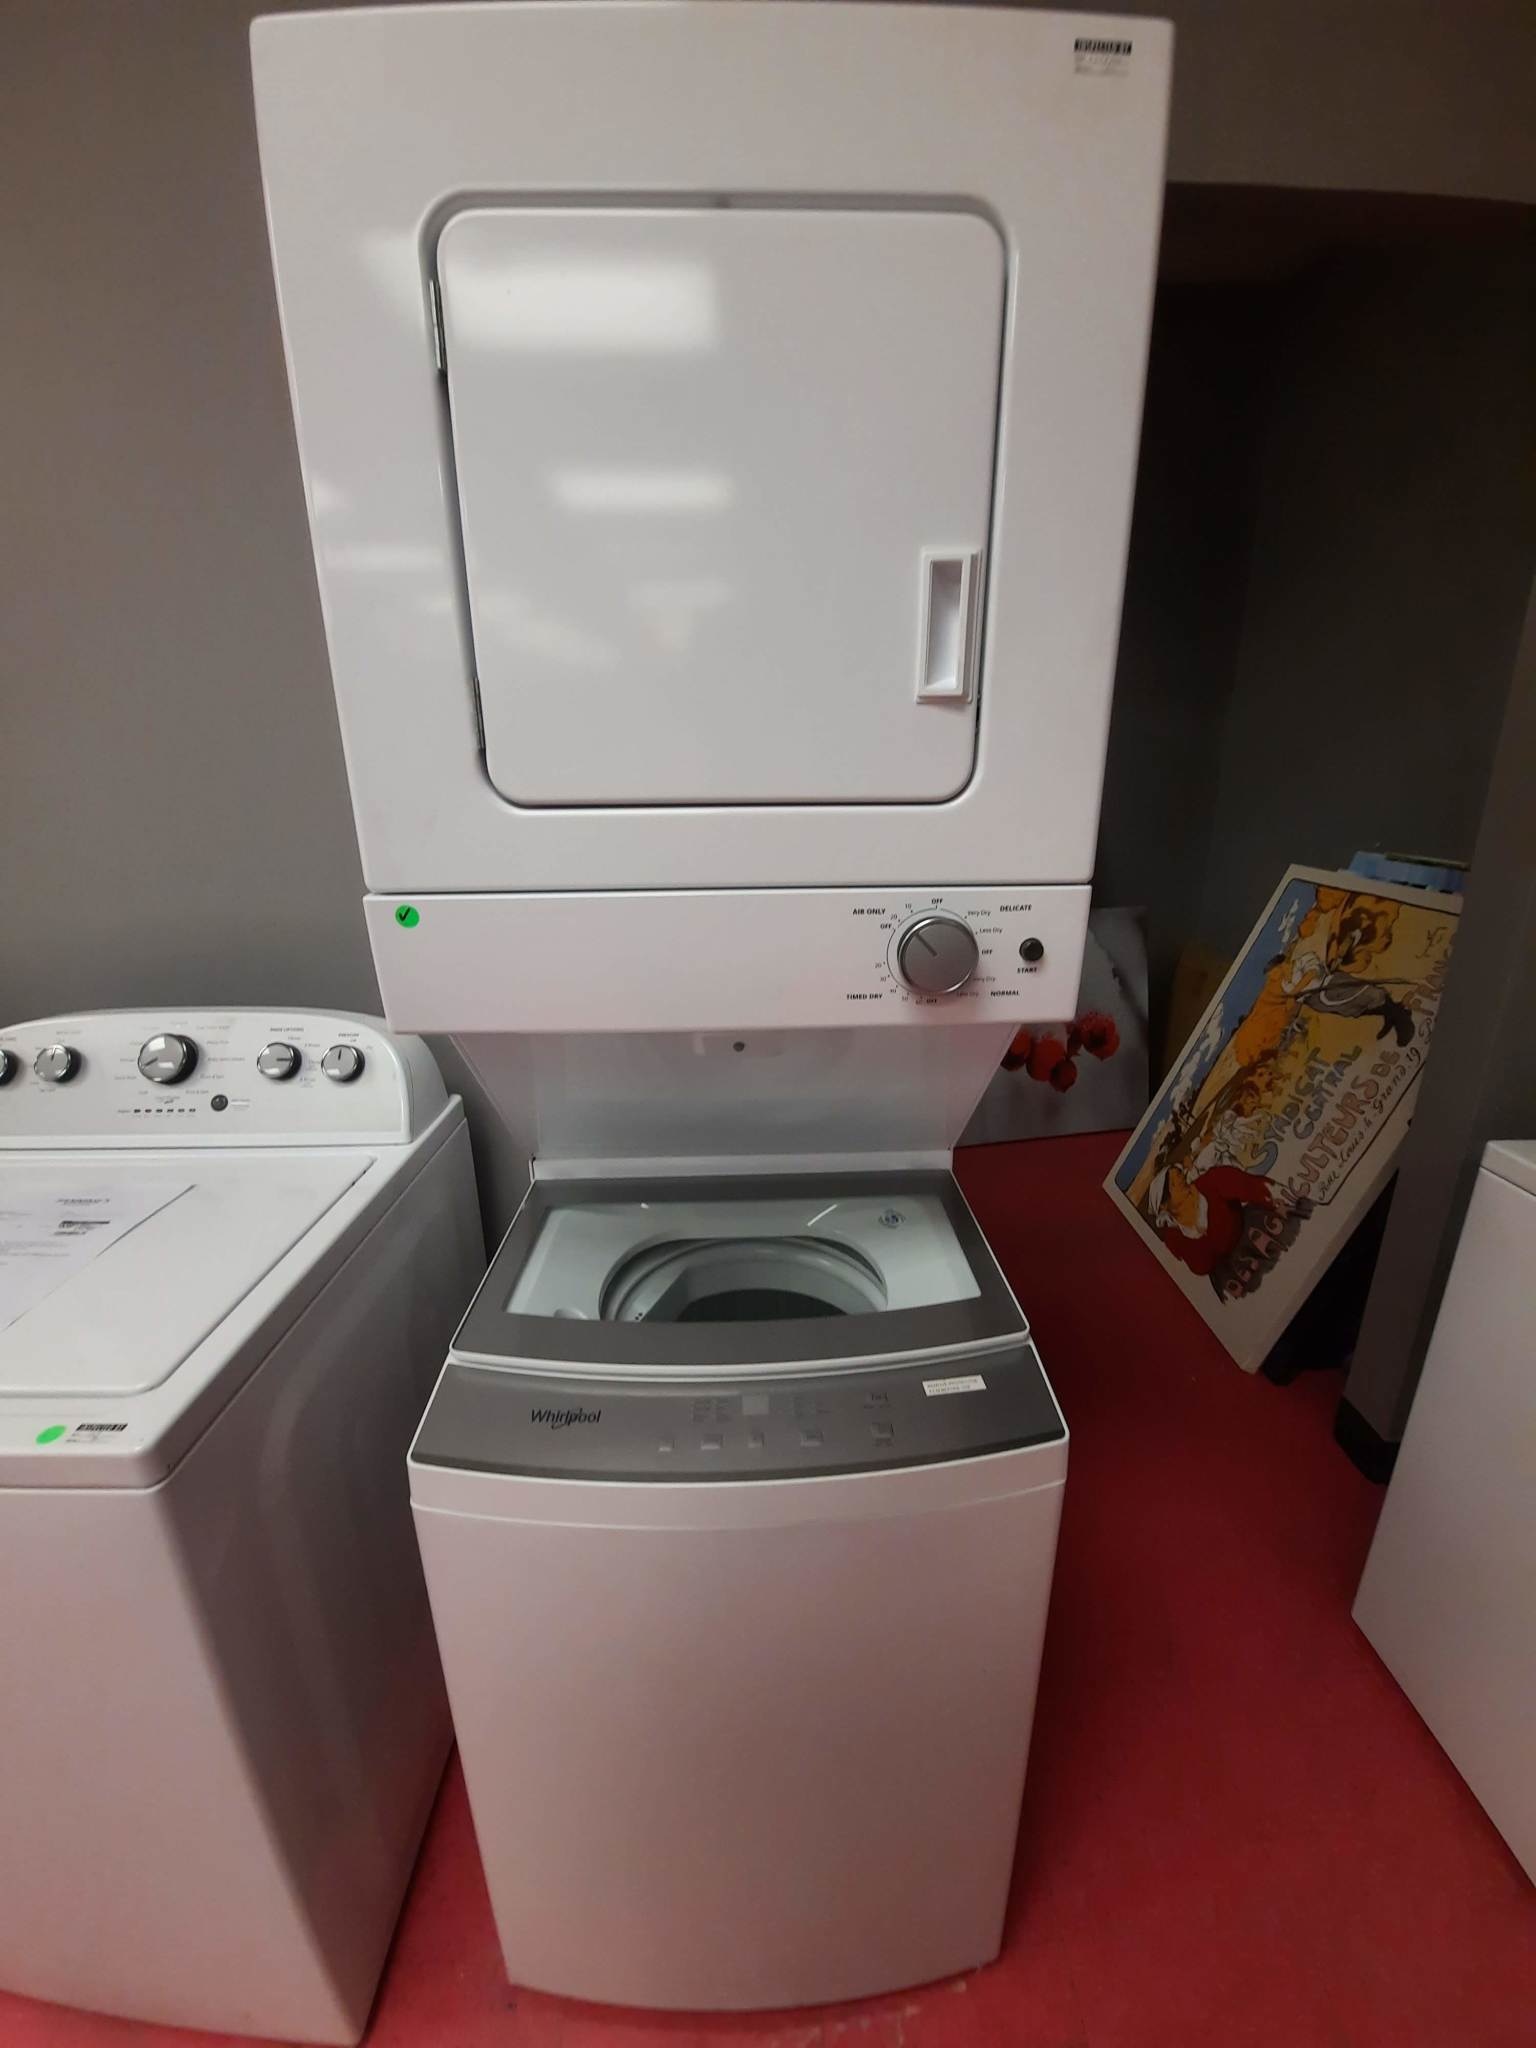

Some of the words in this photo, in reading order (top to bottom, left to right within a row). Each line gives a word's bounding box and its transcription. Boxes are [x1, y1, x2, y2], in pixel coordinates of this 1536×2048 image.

[931, 897, 944, 905] OFF
[852, 908, 865, 916] AIR
[866, 907, 887, 916] ONLY
[999, 903, 1033, 913] DELICATE
[981, 948, 993, 956] OFF
[1017, 966, 1039, 974] START
[846, 993, 868, 1001] TIMED
[869, 992, 884, 1000] DRY
[990, 989, 1020, 998] NORMAL
[531, 1407, 602, 1431] Whirlpool
